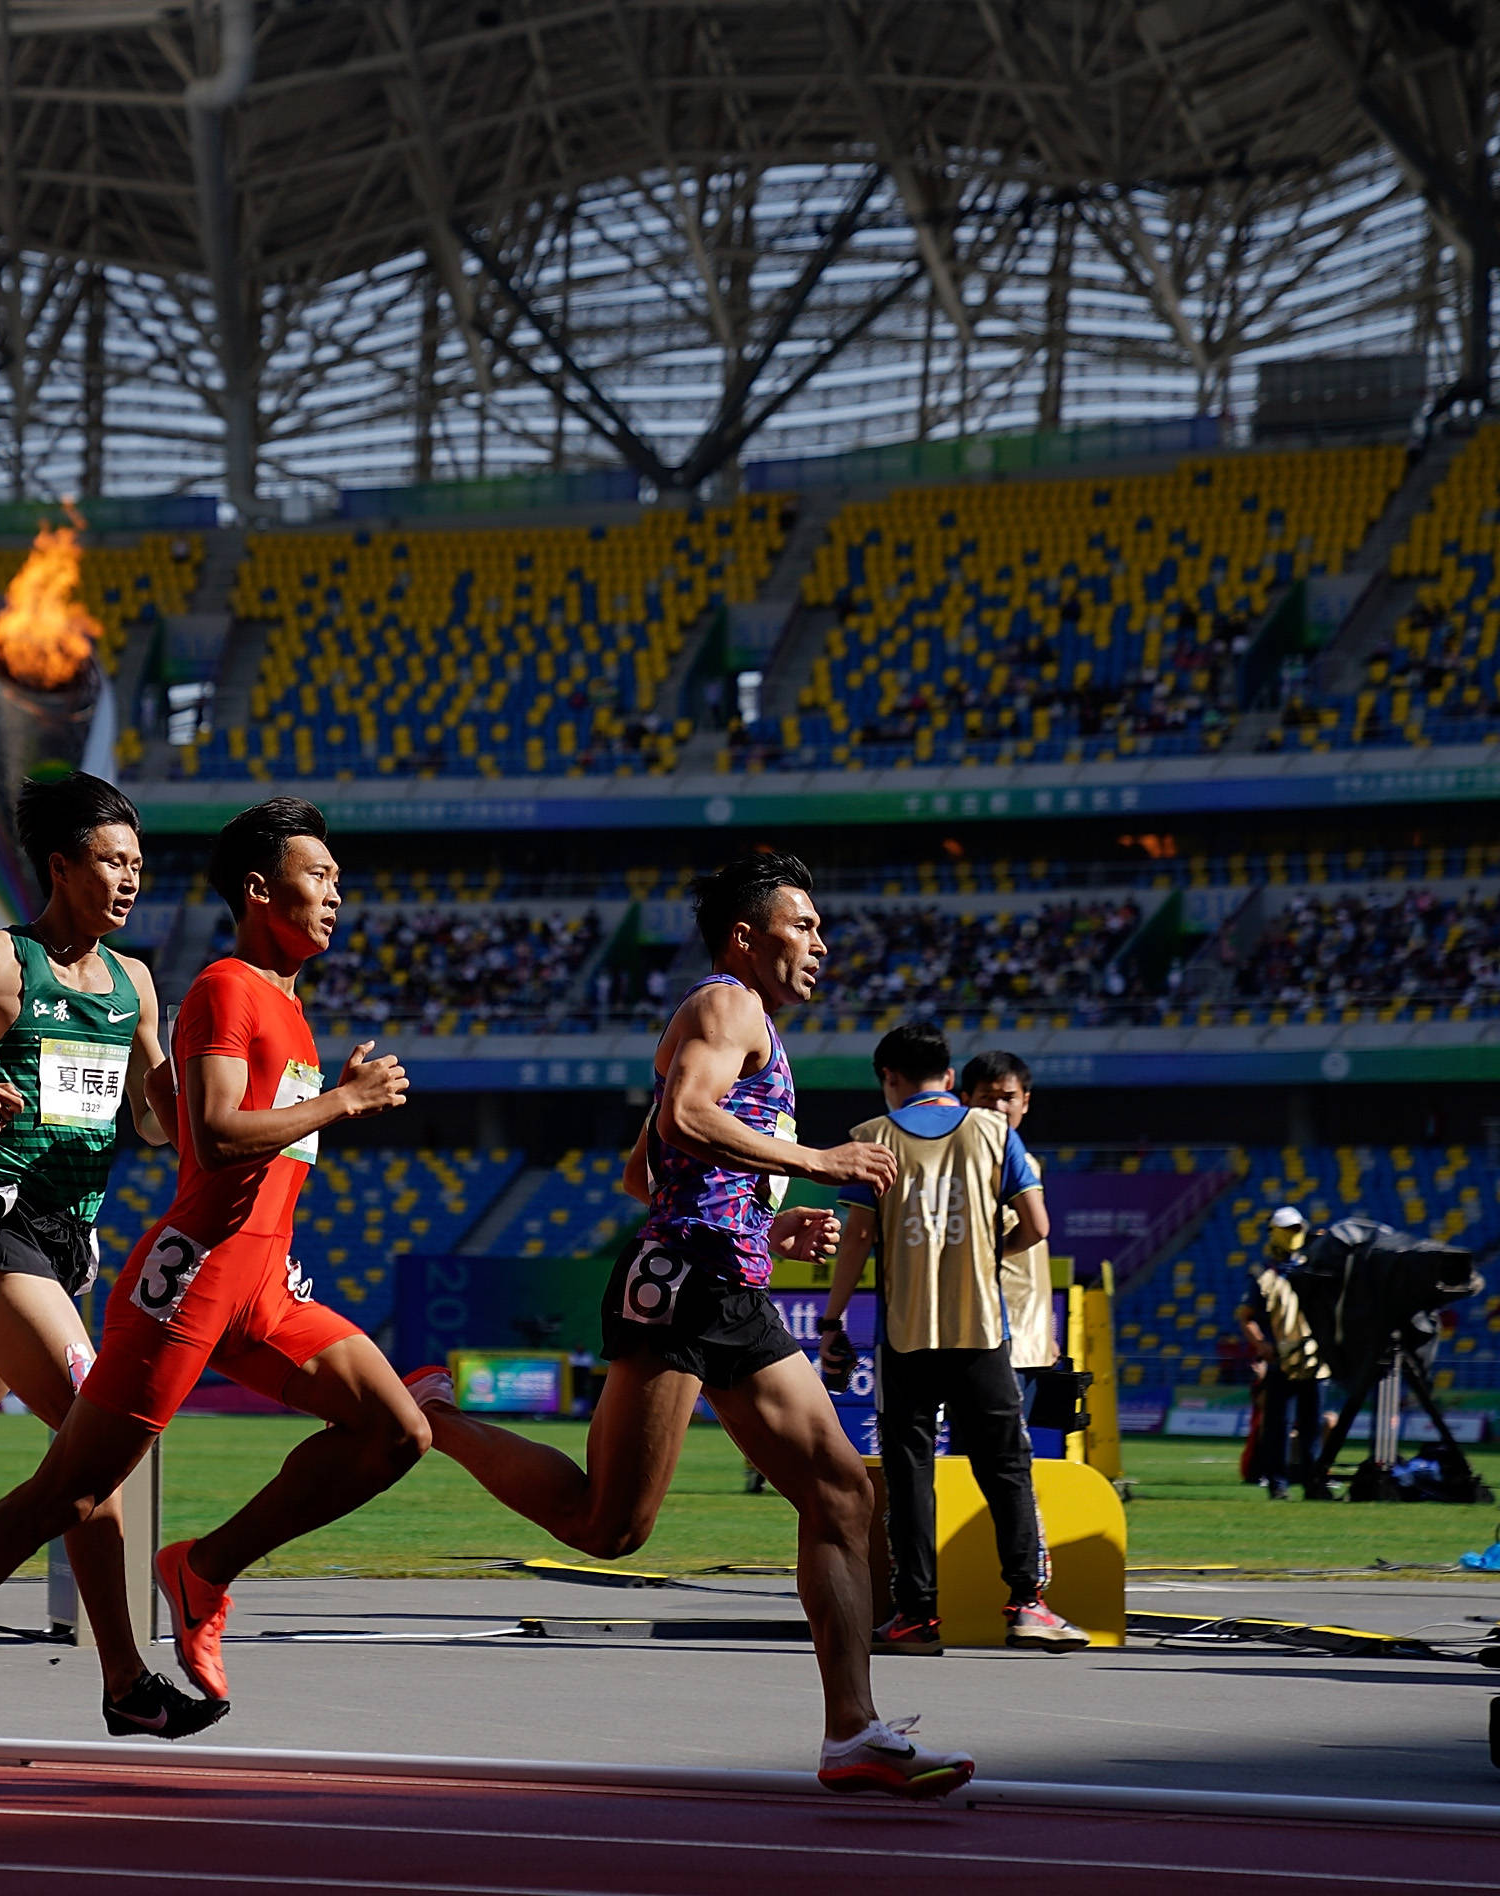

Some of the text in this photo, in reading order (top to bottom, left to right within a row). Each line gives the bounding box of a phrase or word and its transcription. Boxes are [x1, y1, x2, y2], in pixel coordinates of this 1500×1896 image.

[32, 998, 70, 1022] 江苏
[57, 1065, 120, 1098] 夏辰禹
[140, 1235, 195, 1309] 3
[628, 1247, 684, 1319] 8
